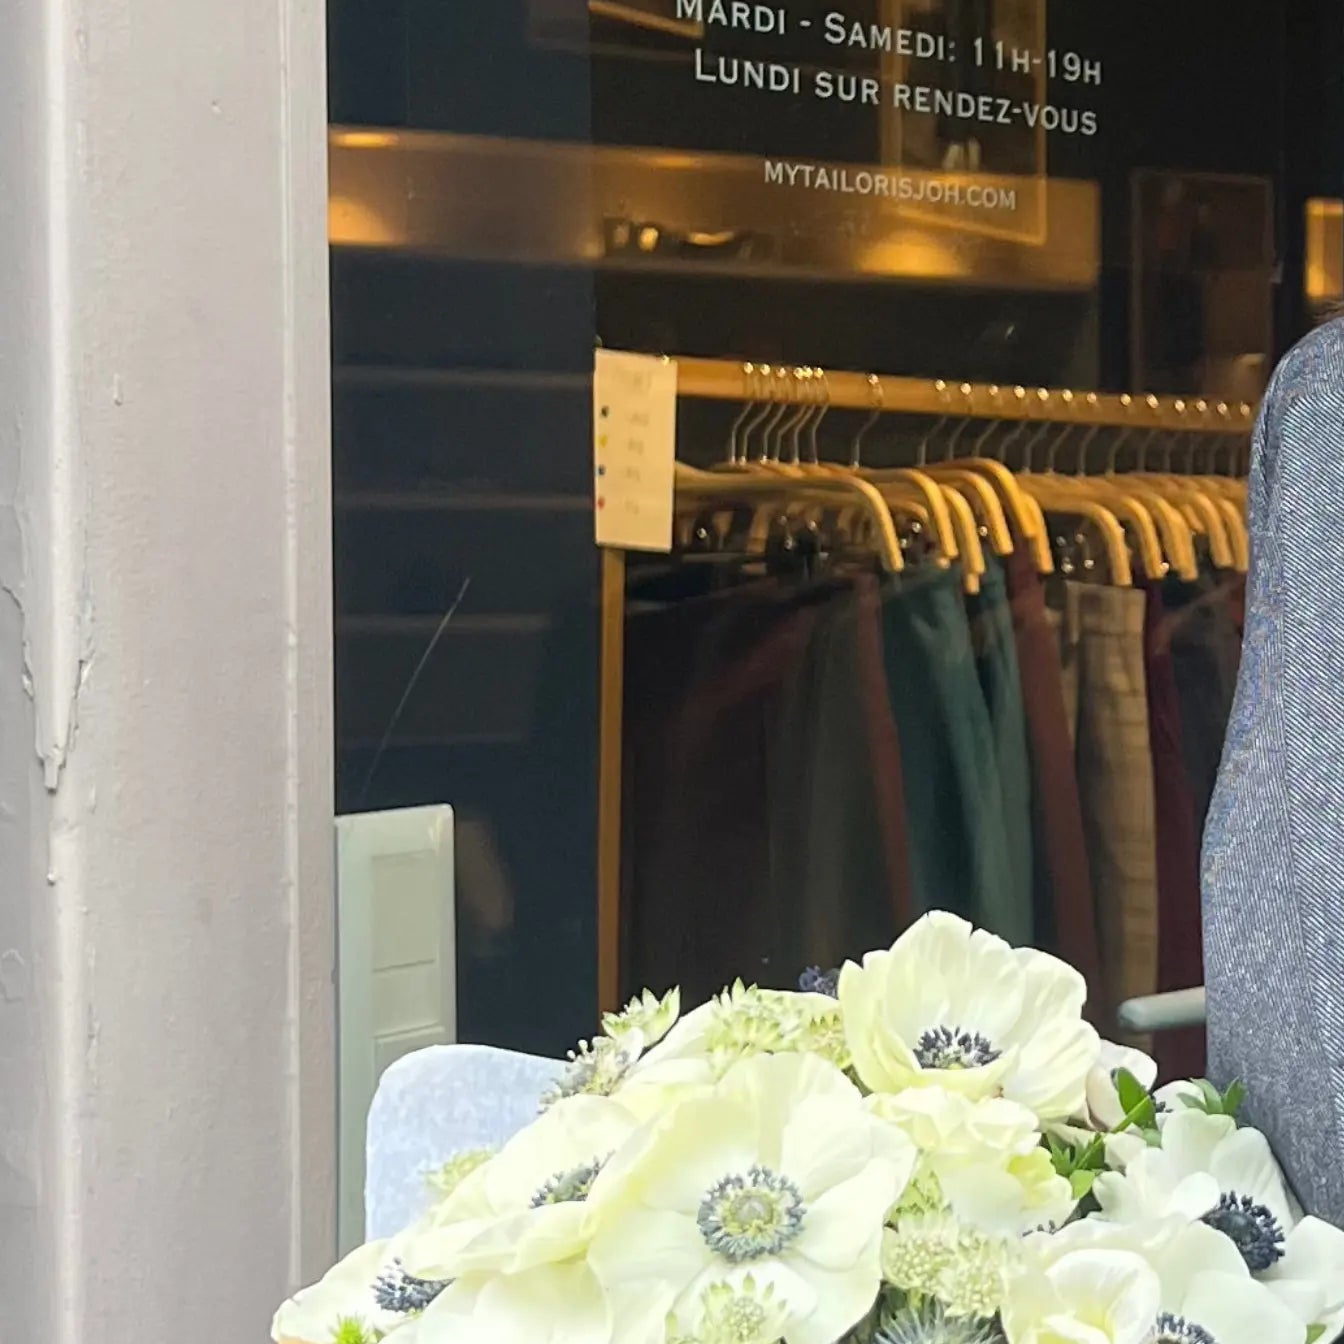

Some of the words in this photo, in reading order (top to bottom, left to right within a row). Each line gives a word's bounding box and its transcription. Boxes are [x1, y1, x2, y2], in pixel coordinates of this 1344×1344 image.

[695, 48, 800, 94] LUNDI
[814, 73, 881, 105] SUR
[893, 87, 1098, 135] RENDEZ-VOUS
[763, 160, 1017, 213] MYTAILORISJOH.COM
